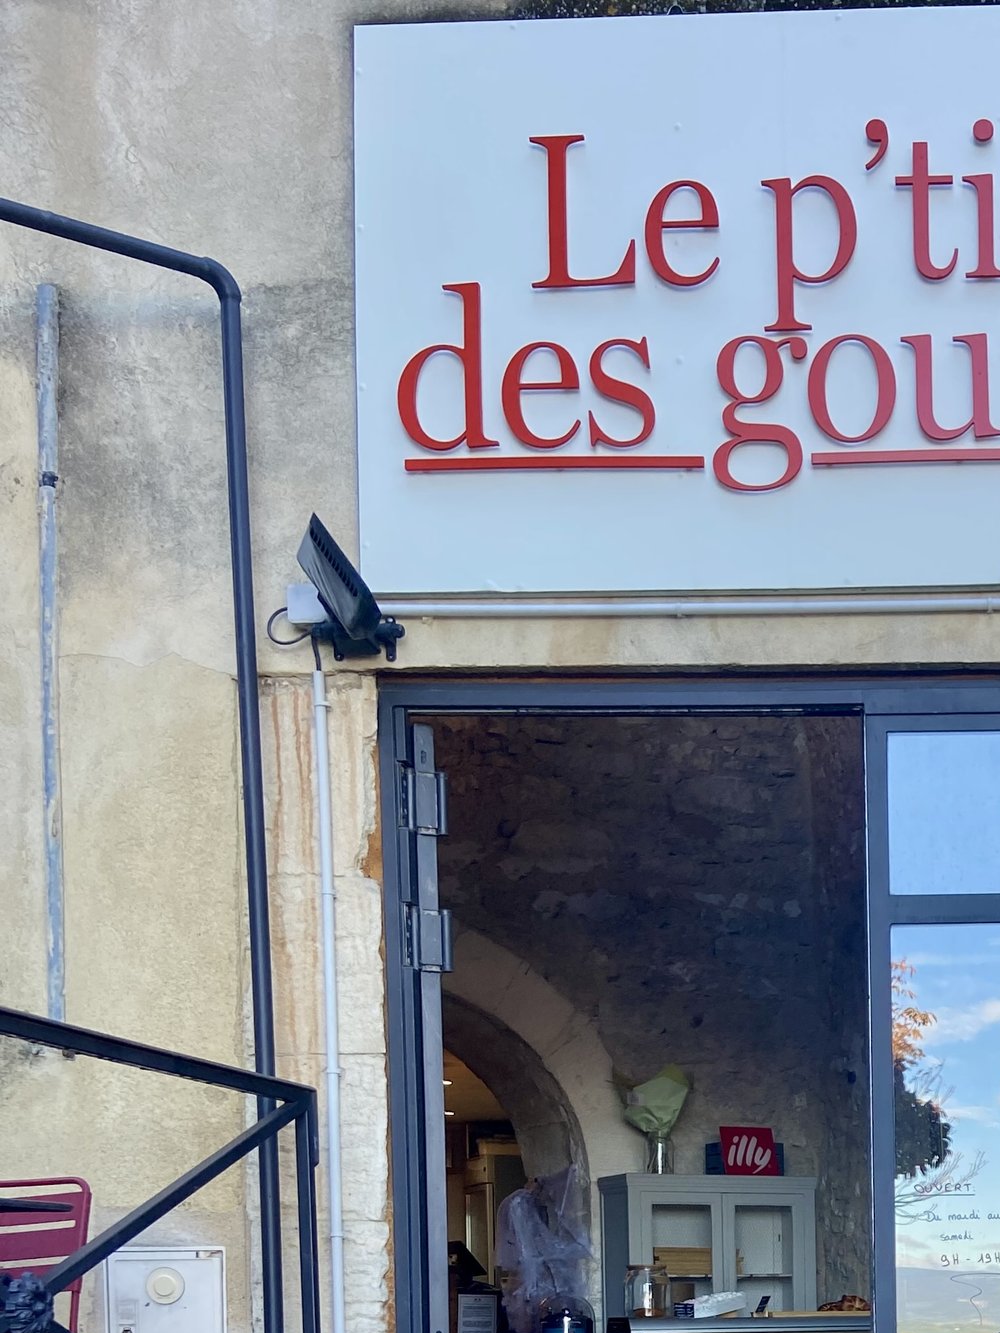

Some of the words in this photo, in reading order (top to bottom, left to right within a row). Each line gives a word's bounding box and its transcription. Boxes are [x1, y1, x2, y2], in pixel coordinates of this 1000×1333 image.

[529, 134, 720, 288] Le
[397, 282, 656, 451] des
[727, 1134, 773, 1174] illy
[939, 1230, 974, 1242] samedi
